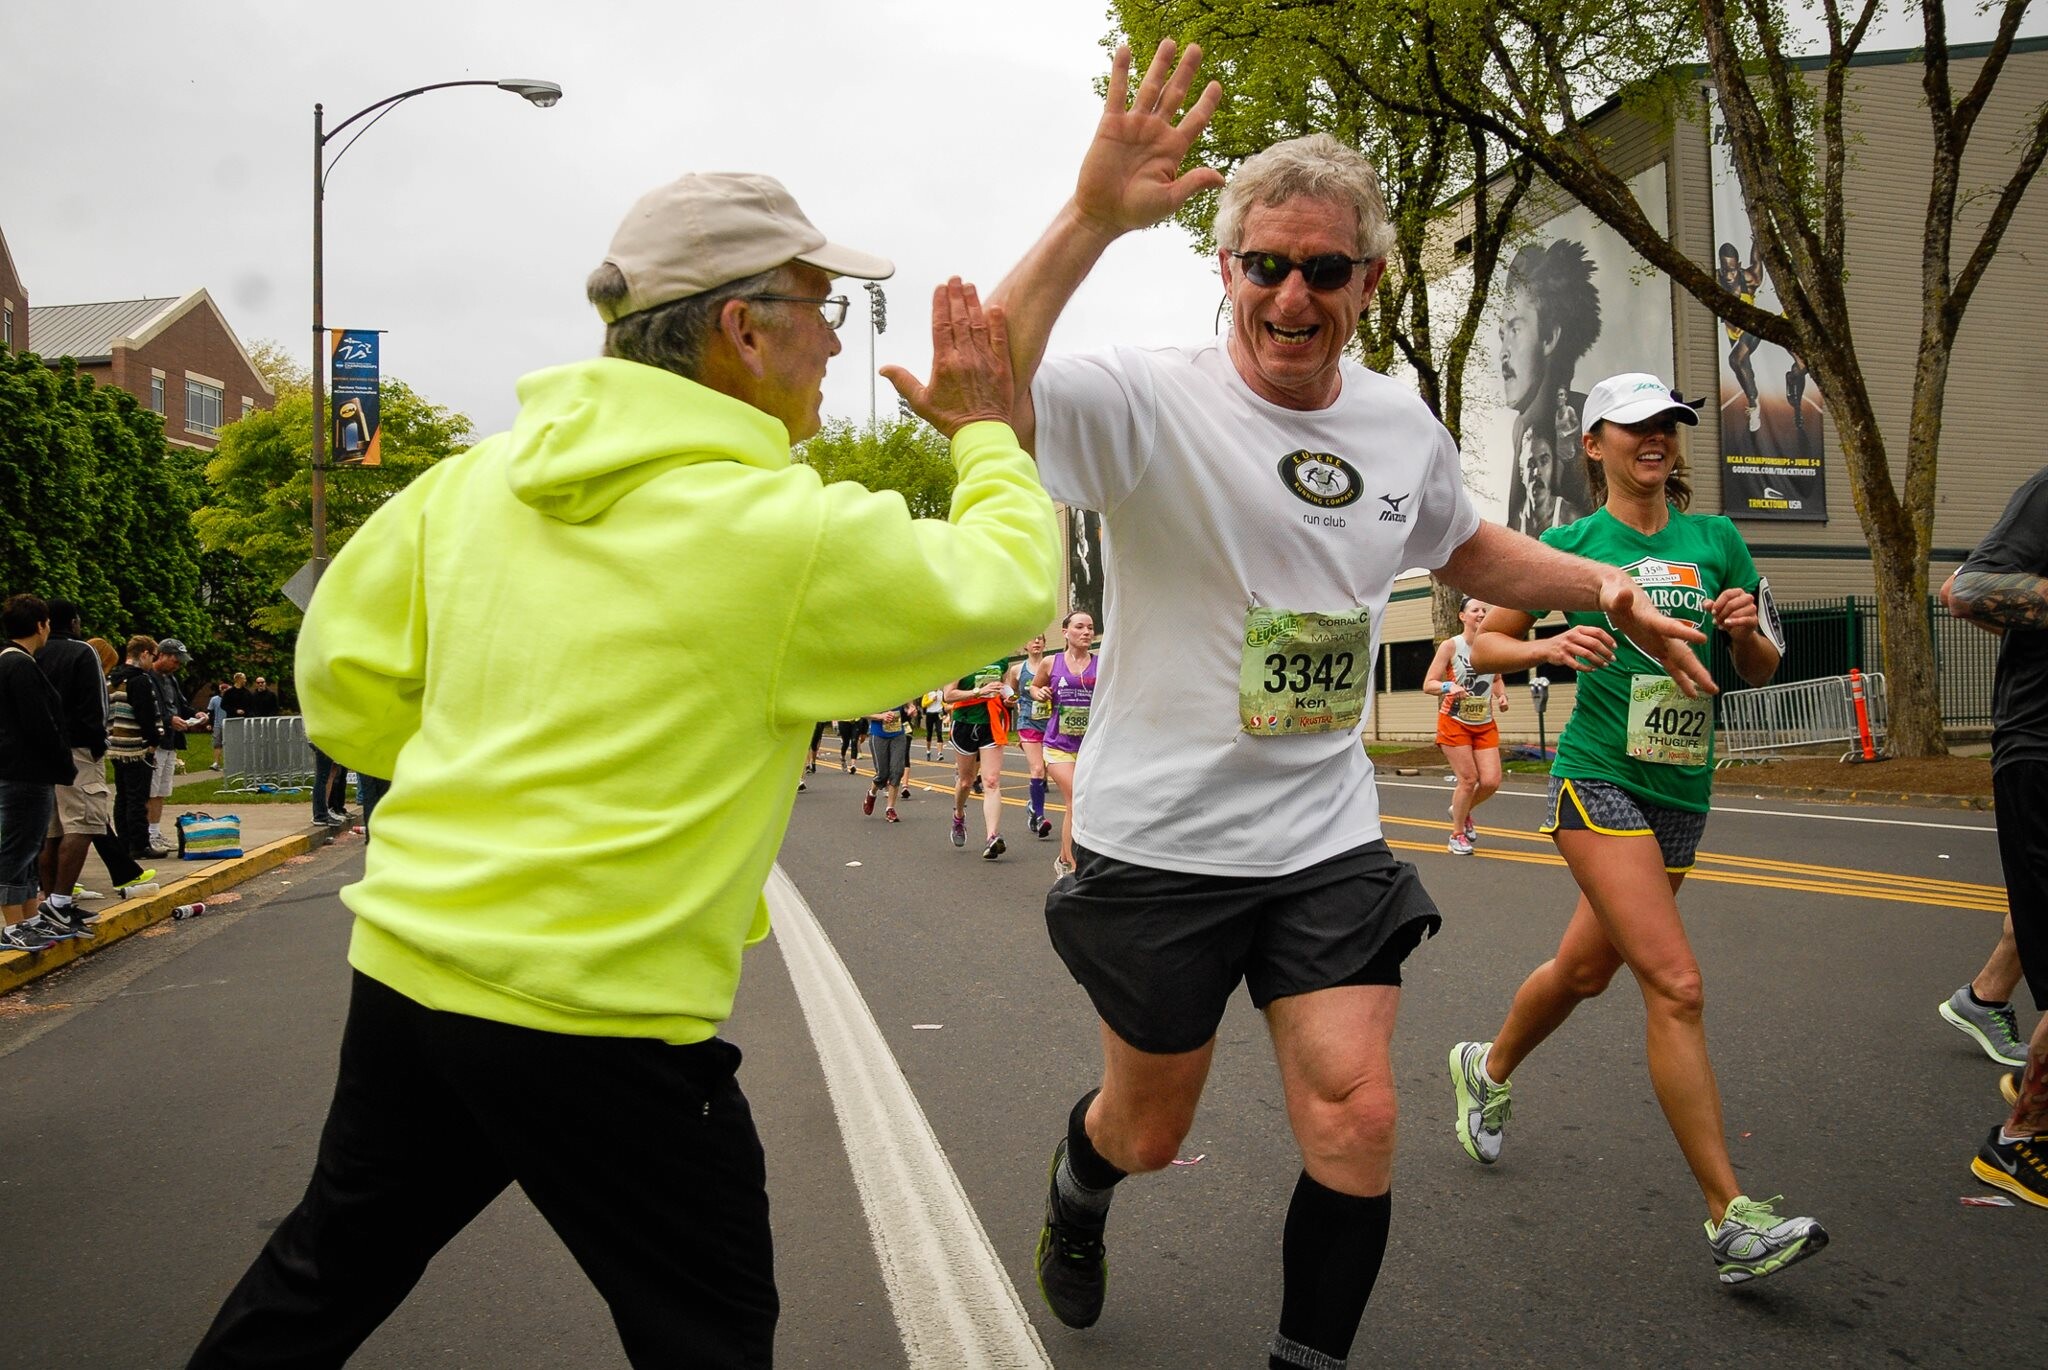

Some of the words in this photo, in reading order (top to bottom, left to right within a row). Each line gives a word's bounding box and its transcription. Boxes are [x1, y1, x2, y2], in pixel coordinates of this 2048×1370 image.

[1292, 451, 1342, 467] EUENE
[1727, 456, 1743, 464] NCAA
[1744, 456, 1790, 466] CHAMPIONSHIPS
[1795, 458, 1809, 466] JUNE
[1294, 481, 1323, 505] RUNNING
[1325, 489, 1355, 506] COMPANY
[1748, 499, 1788, 509] TRACKTOWN
[1788, 500, 1802, 509] USA
[1303, 515, 1320, 525] run
[1323, 515, 1346, 528] club
[1644, 589, 1706, 612] MROCK
[1318, 618, 1357, 627] CORRAL
[1359, 612, 1368, 624] C
[1256, 617, 1297, 643] EUGENE
[1311, 630, 1369, 643] MARATHON
[1263, 651, 1354, 694] 3342
[1295, 697, 1327, 709] Ken
[1064, 716, 1088, 727] 4388
[1644, 706, 1706, 738] 4022
[1648, 736, 1699, 749] THUGLIFE
